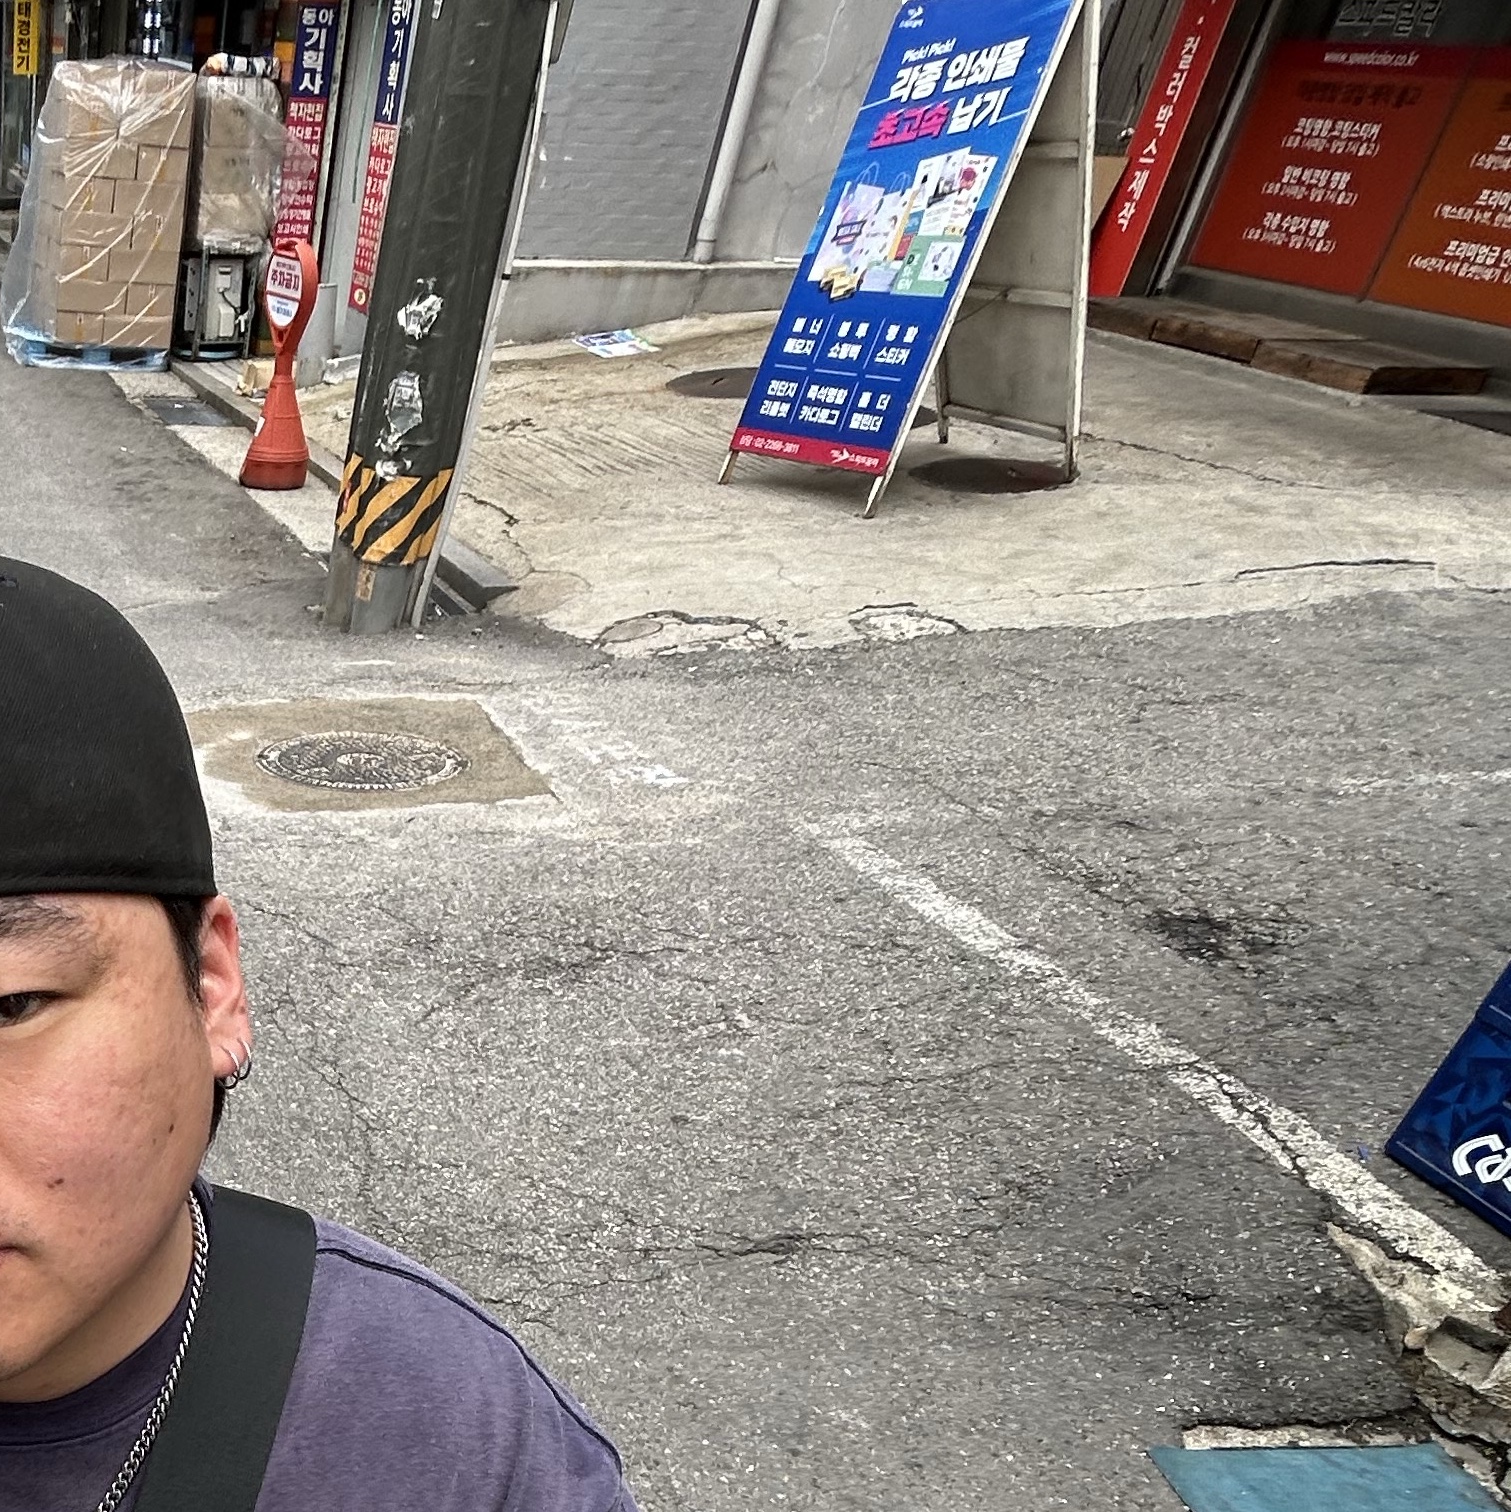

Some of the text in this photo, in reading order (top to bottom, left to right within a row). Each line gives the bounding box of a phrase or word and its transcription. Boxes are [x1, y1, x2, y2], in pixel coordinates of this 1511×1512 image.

[302, 7, 334, 26] 동아
[299, 28, 327, 95] 기획사
[888, 36, 1031, 103] 각종 인쇄물
[382, 28, 405, 121] 기획사
[868, 86, 1013, 149] 초고속 납기
[271, 269, 300, 291] 주차금지
[874, 346, 912, 366] 스티커
[767, 379, 798, 398] 전단지
[798, 405, 841, 426] 카다로그
